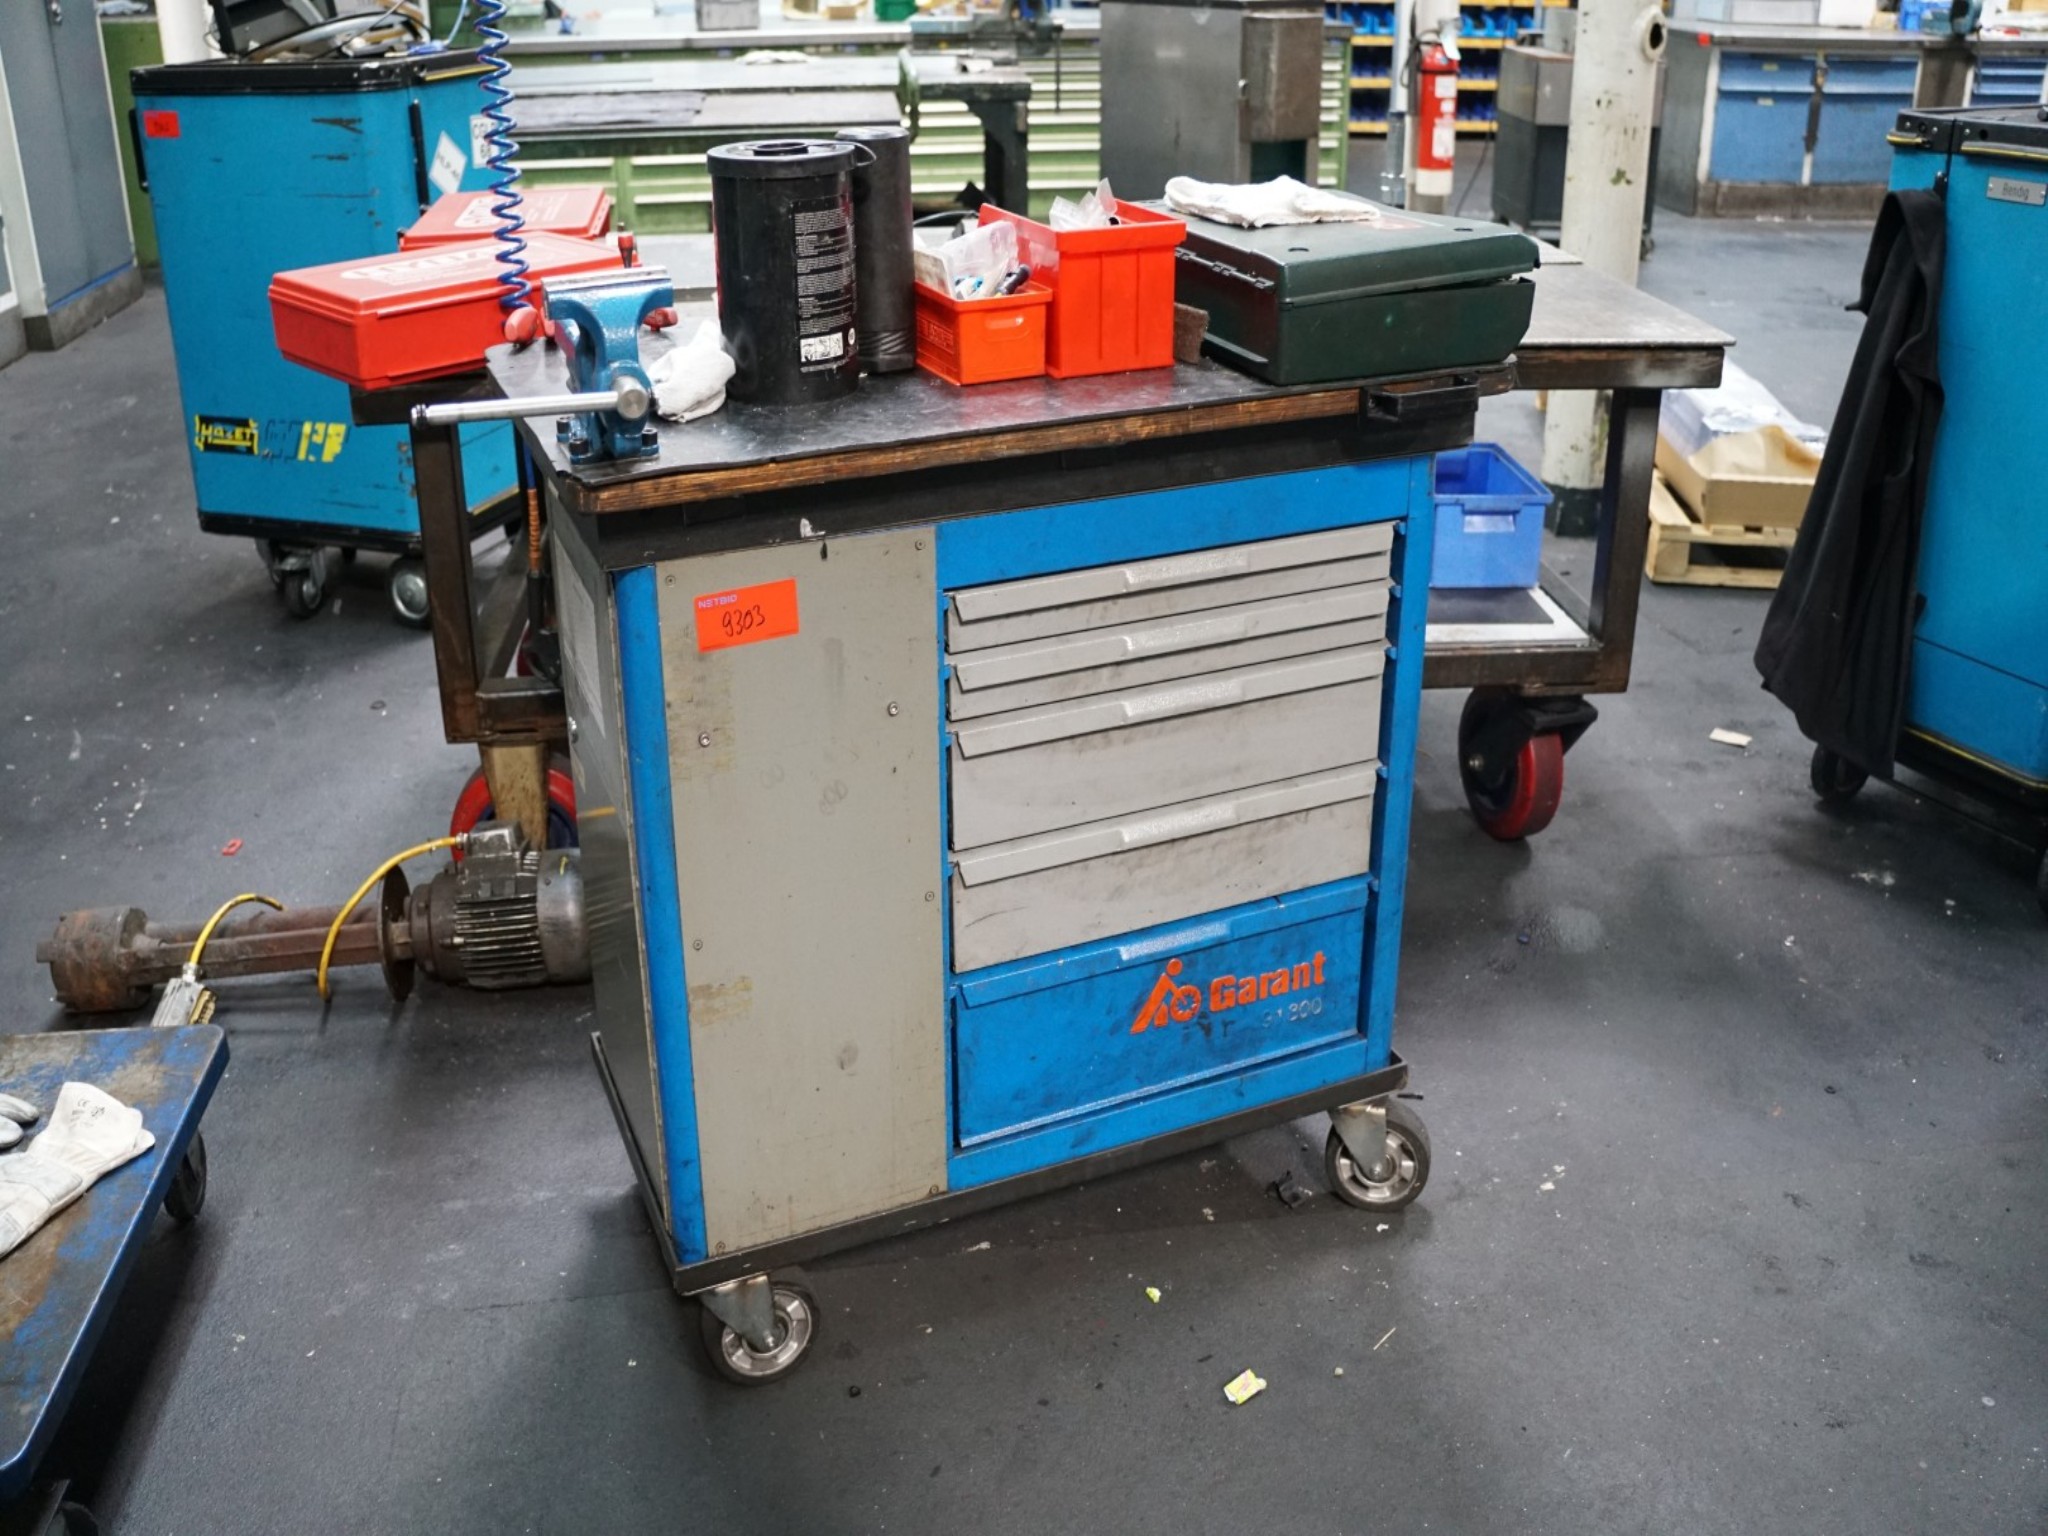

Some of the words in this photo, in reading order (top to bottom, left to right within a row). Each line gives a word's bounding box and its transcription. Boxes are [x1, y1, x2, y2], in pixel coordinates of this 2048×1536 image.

[698, 594, 738, 609] NETBID
[722, 604, 766, 637] 9303
[1209, 951, 1327, 1012] Garant
